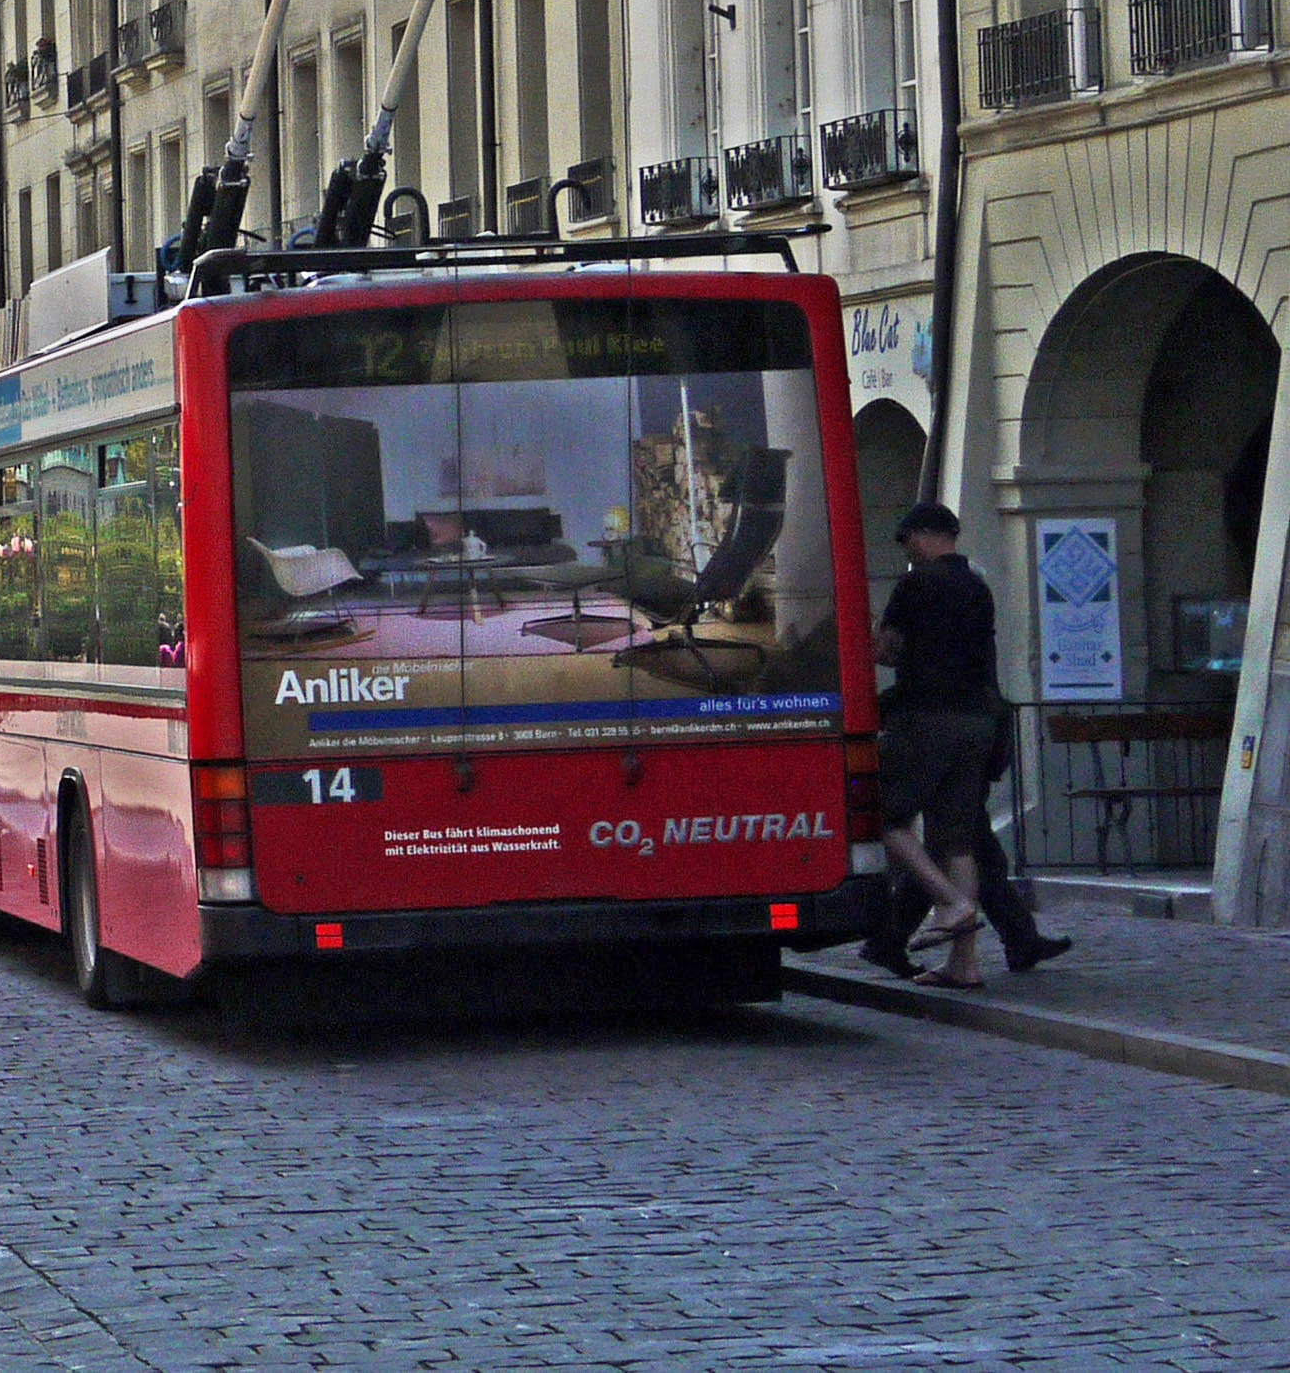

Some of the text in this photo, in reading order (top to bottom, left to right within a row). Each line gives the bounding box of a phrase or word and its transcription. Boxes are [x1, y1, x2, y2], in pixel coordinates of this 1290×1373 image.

[851, 303, 901, 357] Blue Cat
[357, 330, 405, 376] 12
[274, 667, 411, 705] Anliker
[700, 696, 732, 712] alles
[772, 694, 830, 709] wohnen
[309, 737, 340, 748] Anliker
[342, 736, 357, 747] die
[535, 728, 558, 739] Bern
[301, 767, 357, 804] 14
[384, 823, 561, 842] Dieser Bus fährt klimaschonend
[663, 811, 834, 847] NEUTRAL
[385, 838, 561, 857] mit Elektrizität aus Wasserkraft.
